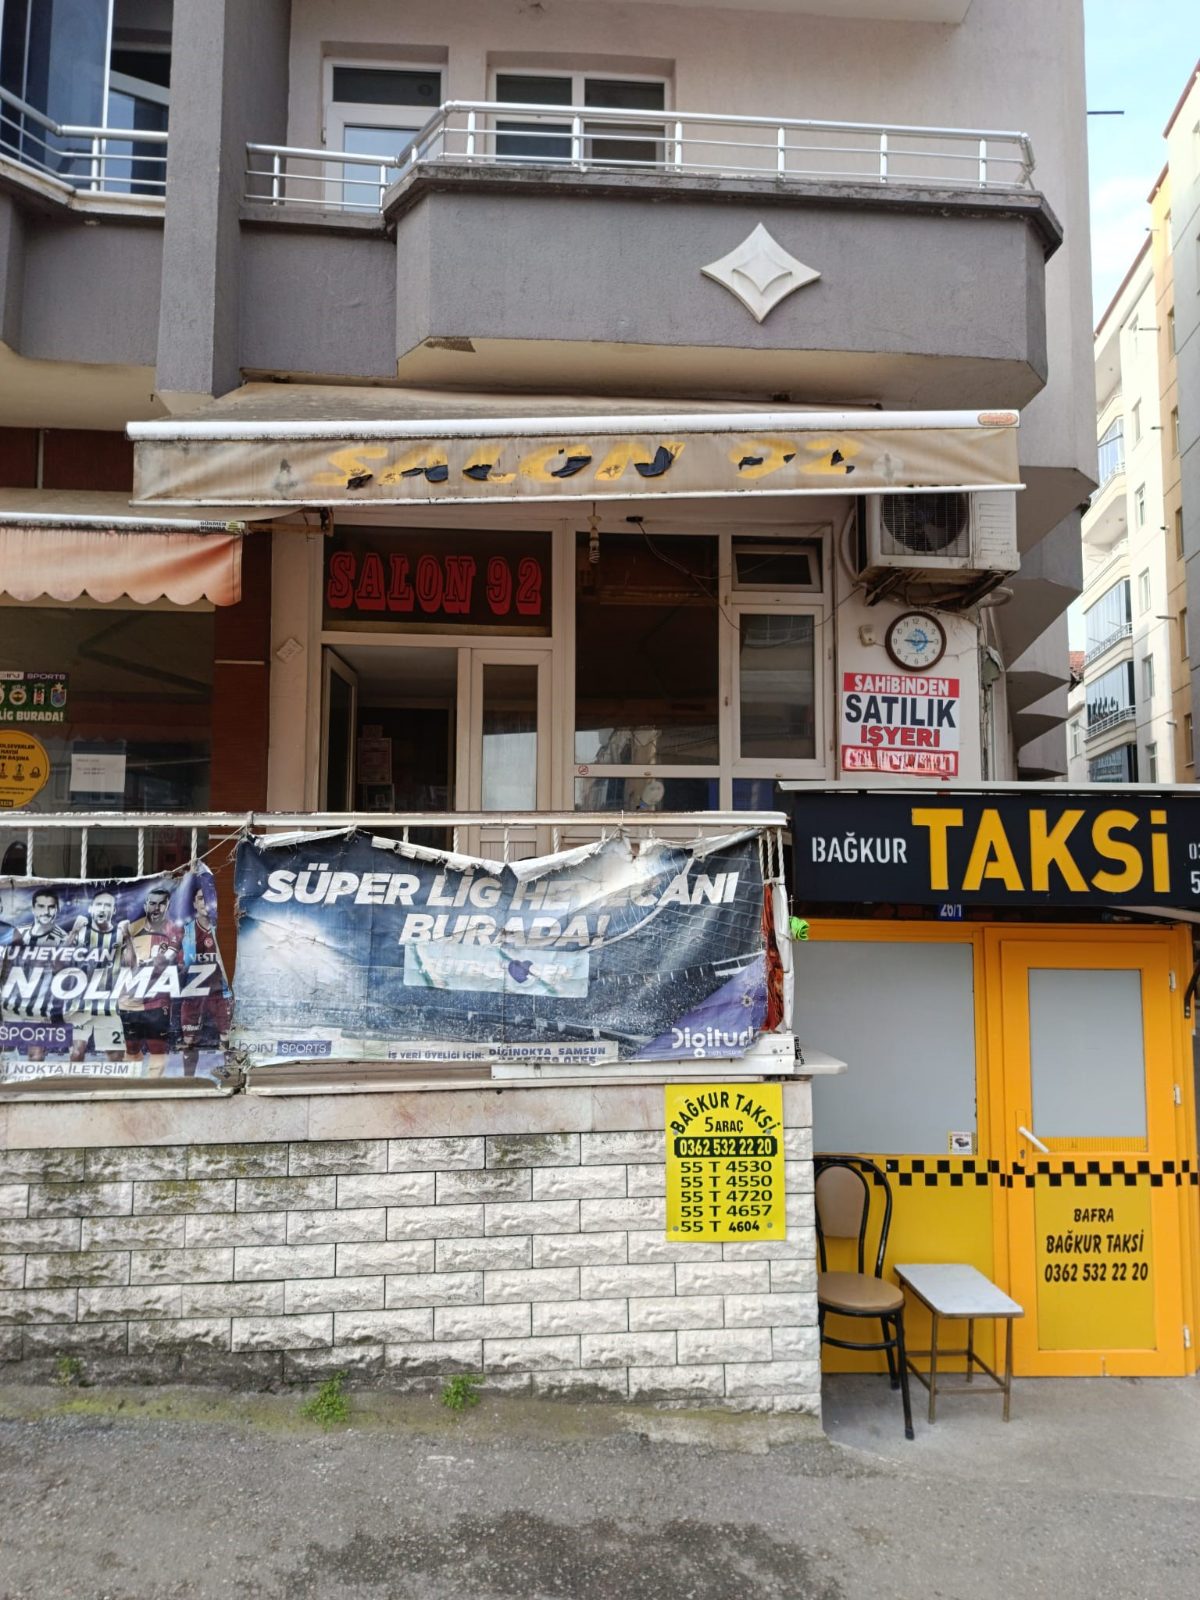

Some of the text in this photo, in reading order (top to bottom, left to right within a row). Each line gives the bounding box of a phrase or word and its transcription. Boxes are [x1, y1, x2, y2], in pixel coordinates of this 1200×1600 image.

[328, 551, 543, 615] SALON 92
[27, 672, 66, 680] SPORTS
[16, 711, 64, 722] BURADA!
[845, 694, 956, 728] SATILIK
[811, 832, 908, 864] BAĞKUR
[1188, 843, 1200, 860] 0
[262, 862, 421, 906] SÜPER
[509, 871, 740, 911] HEECANI
[398, 913, 612, 947] BURADA!
[22, 946, 116, 962] HEYECAN
[50, 963, 217, 1000] OLMAZ
[0, 1027, 67, 1042] SPORTS
[281, 1043, 327, 1055] SPORTS
[558, 1046, 607, 1056] SAMSUN
[13, 1063, 64, 1075] NOKTA
[68, 1062, 130, 1078] İLETİŞİM
[670, 1091, 730, 1134] BAĞKUR
[715, 1120, 744, 1134] ARAÇ
[680, 1138, 772, 1156] 0362 532 22 20
[680, 1160, 773, 1174] 55 T 4530
[680, 1175, 773, 1188] 55 T 4550
[680, 1190, 773, 1203] 55 T 4720
[680, 1204, 773, 1218] 55 T 4657
[1073, 1208, 1115, 1223] BAFRA
[680, 1220, 760, 1233] 55 T 4604
[1046, 1229, 1145, 1255] BAĞKUR TAKSİ
[1044, 1262, 1149, 1283] 0362 532 22 20
